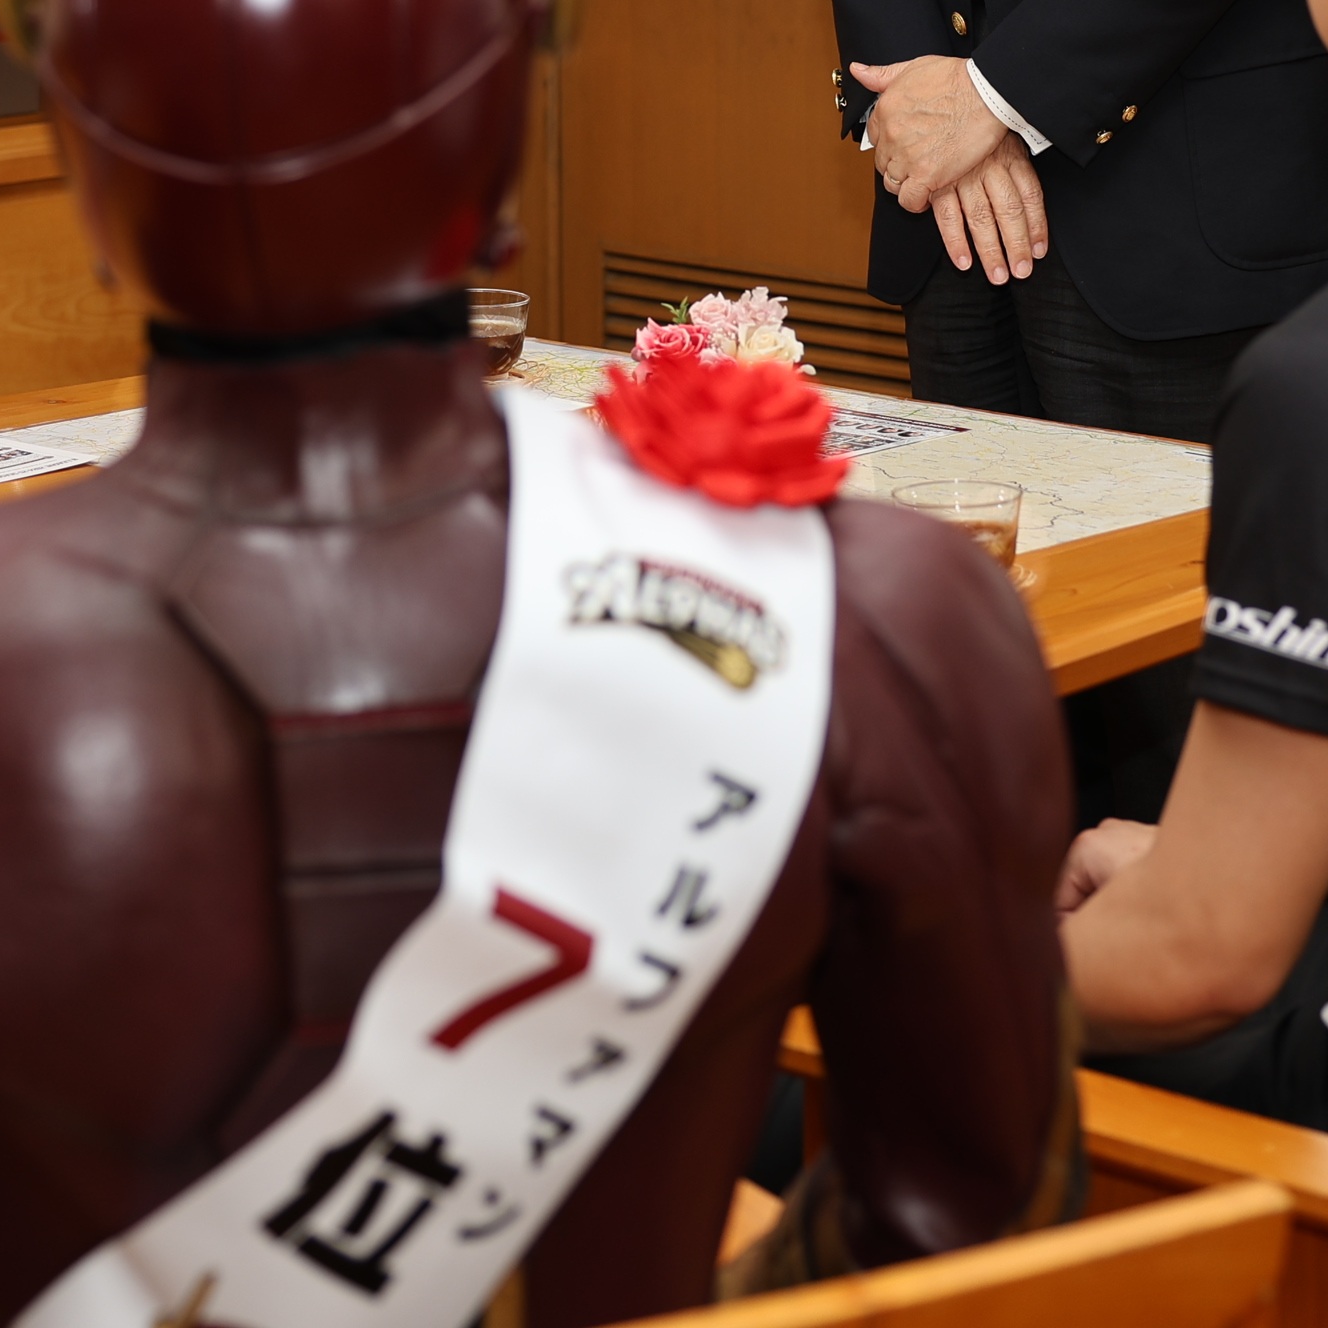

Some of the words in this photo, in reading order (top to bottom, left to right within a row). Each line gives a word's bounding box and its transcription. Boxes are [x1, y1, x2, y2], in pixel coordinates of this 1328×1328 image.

[460, 767, 760, 1243] アルファマン
